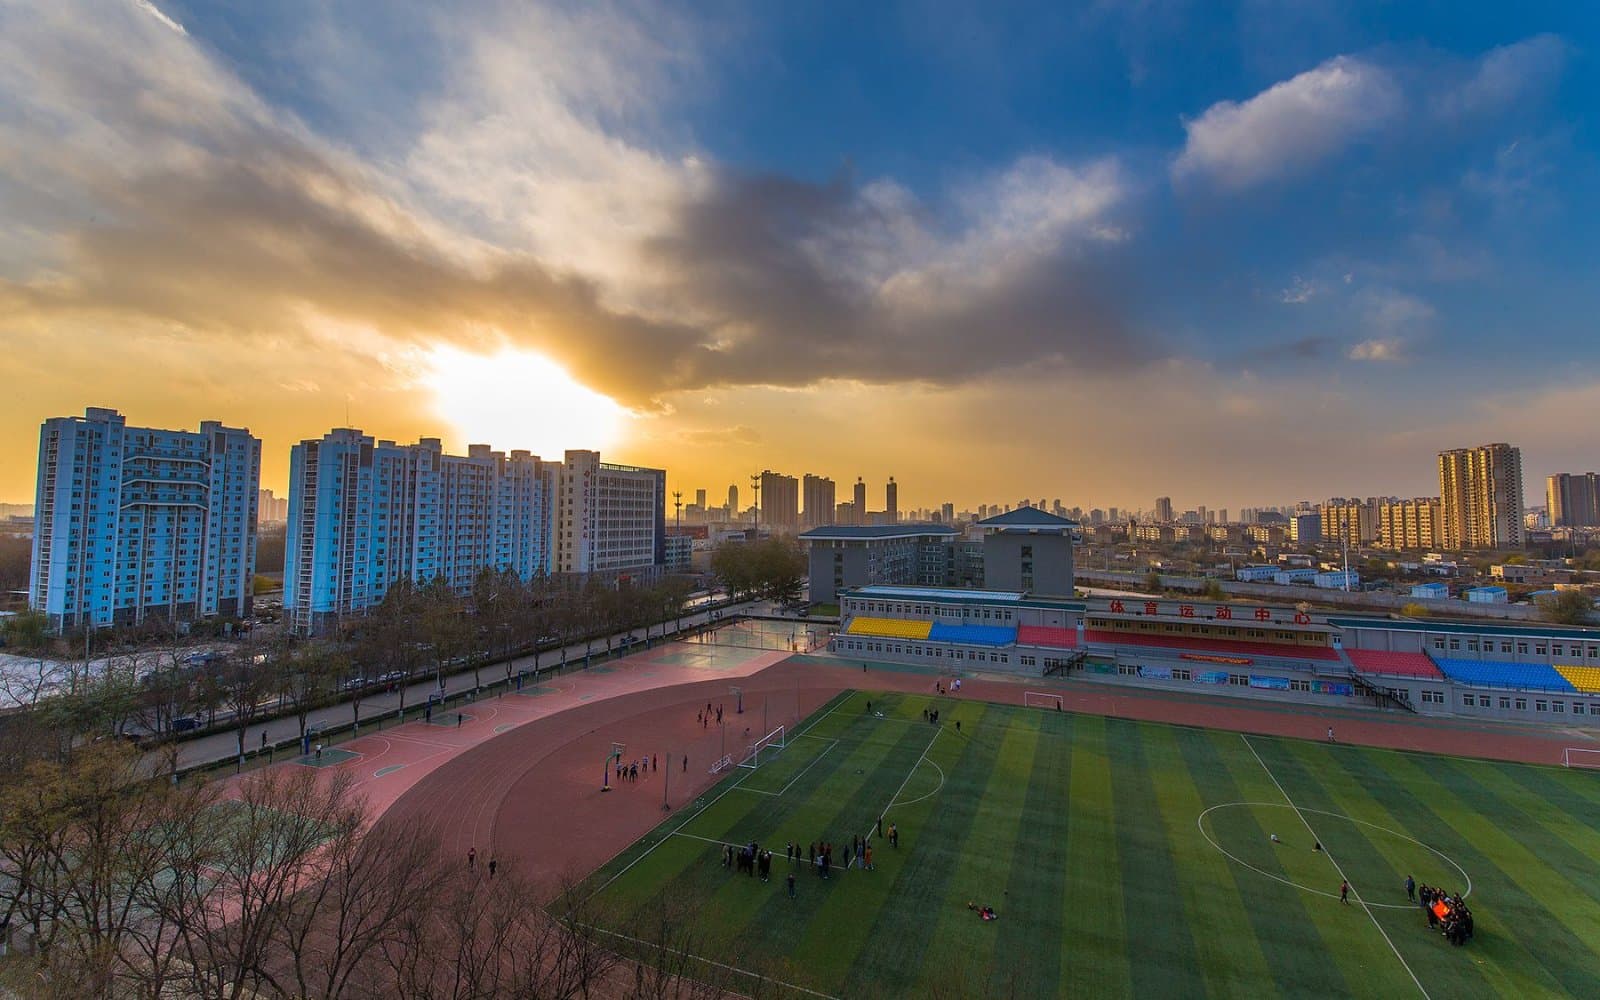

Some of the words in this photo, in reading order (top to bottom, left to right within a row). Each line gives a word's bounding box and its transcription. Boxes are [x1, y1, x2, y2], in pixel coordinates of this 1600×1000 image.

[1110, 600, 1311, 625] 体育运动中心
